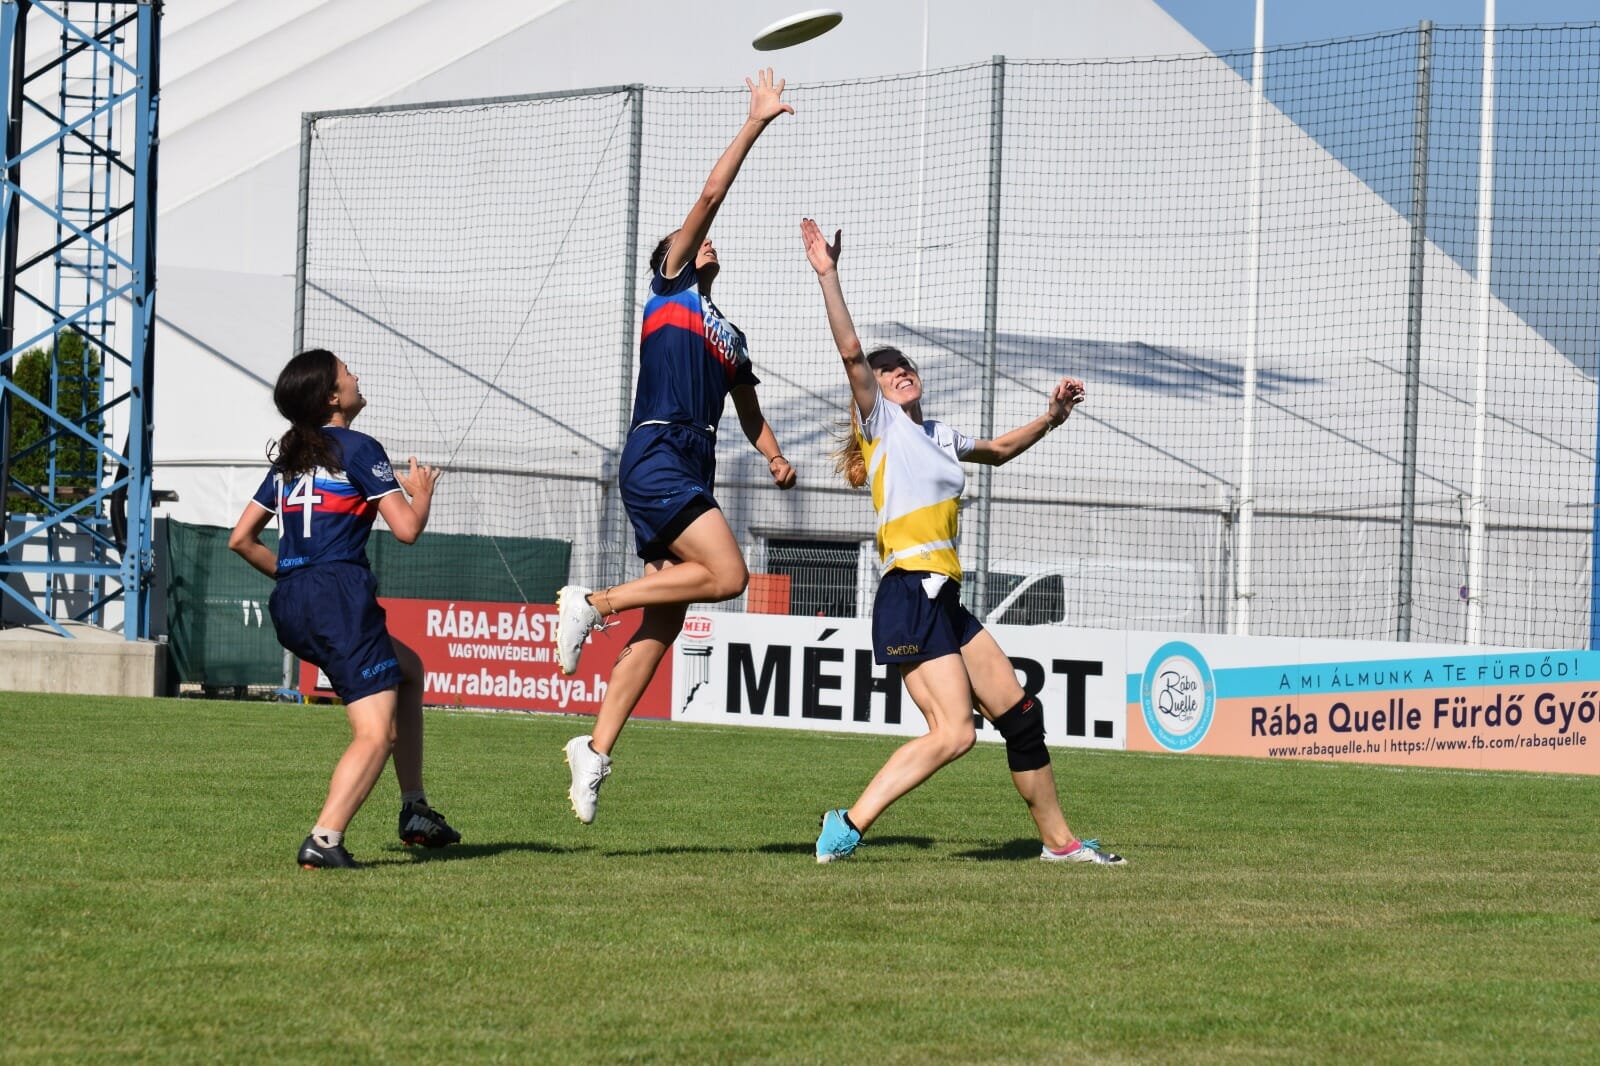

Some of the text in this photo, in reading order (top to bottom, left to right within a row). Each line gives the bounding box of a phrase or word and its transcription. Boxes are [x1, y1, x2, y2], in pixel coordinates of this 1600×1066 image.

[273, 469, 322, 539] 14
[426, 603, 593, 644] RÁBA-BÁST
[684, 621, 711, 632] MEH
[448, 642, 549, 663] VAGYONVÉDELMI
[886, 644, 919, 656] SWEDEN
[726, 628, 902, 725] MÉH
[1160, 671, 1197, 695] Rába
[1279, 674, 1291, 689] A
[1301, 674, 1321, 688] MI
[1331, 667, 1413, 687] ÁLMUNK
[1423, 669, 1434, 682] A
[1159, 690, 1198, 717] Quelle
[1251, 704, 1318, 737] Rába
[1328, 698, 1421, 733] Quelle
[1433, 693, 1525, 728] Fürdő
[1534, 690, 1600, 734] Győ
[1269, 739, 1380, 757] www.rabaquelle.hu
[1390, 732, 1587, 755] https://www.fb.com/rabaquelle
